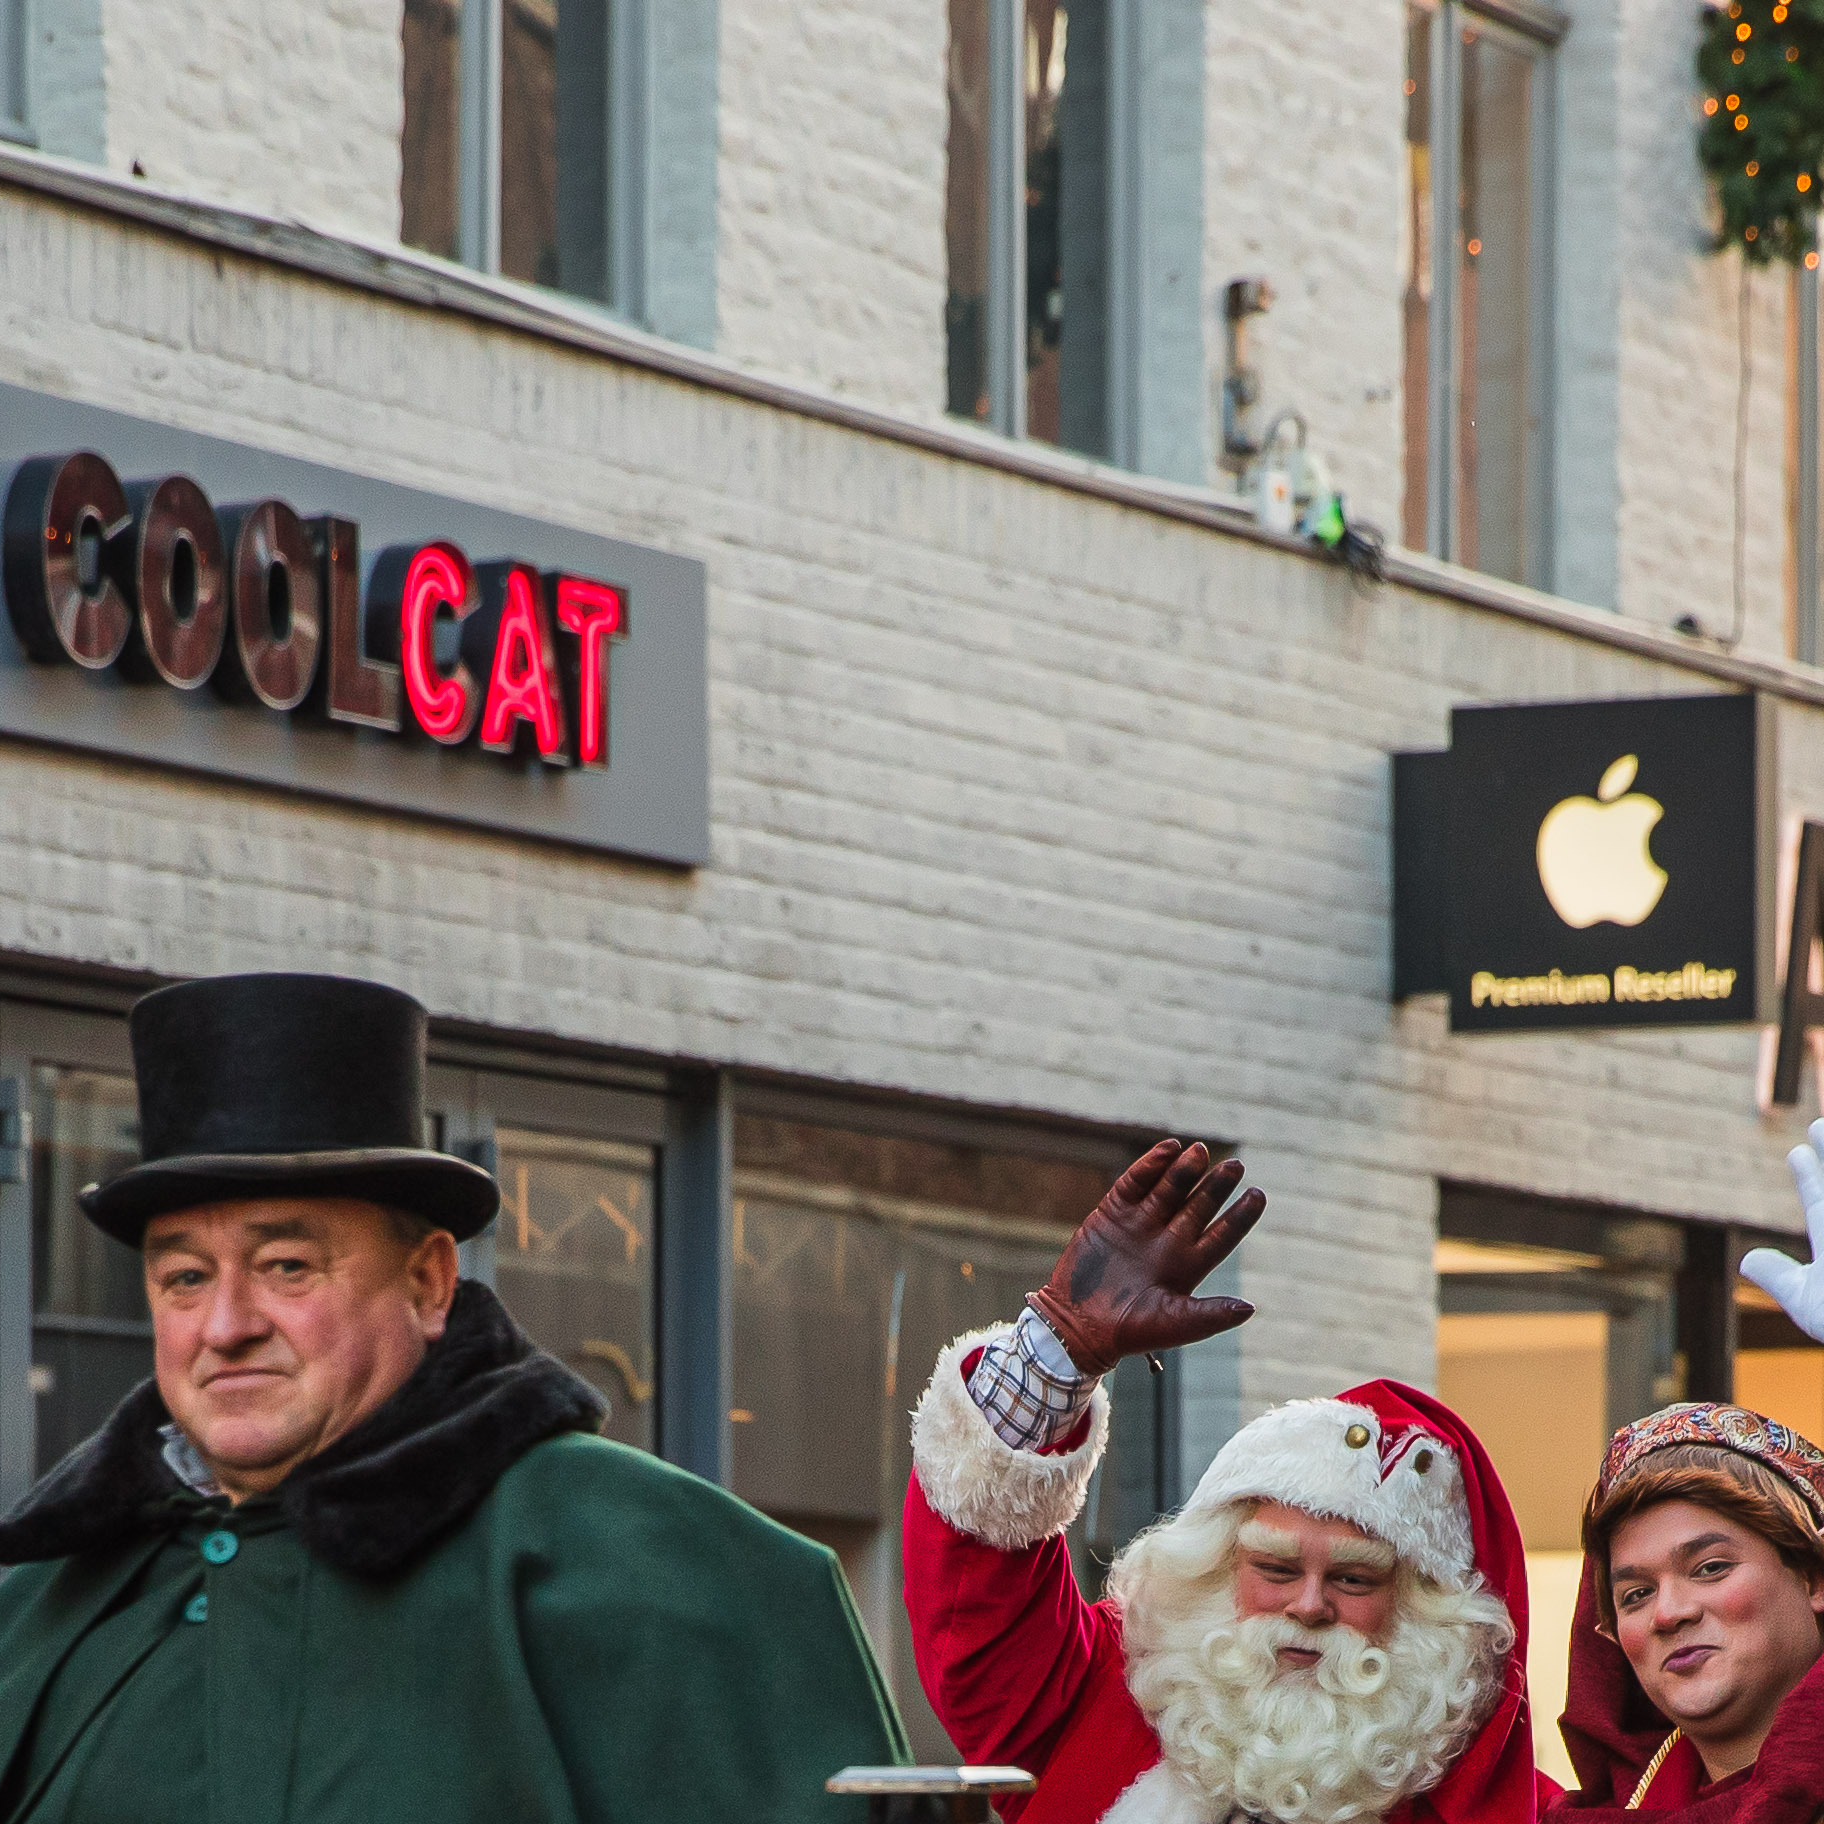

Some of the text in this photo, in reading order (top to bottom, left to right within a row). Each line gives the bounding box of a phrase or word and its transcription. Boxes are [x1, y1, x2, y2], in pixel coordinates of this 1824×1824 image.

[2, 449, 630, 771] COOLCAT
[1471, 961, 1737, 1008] Premium Reseller
